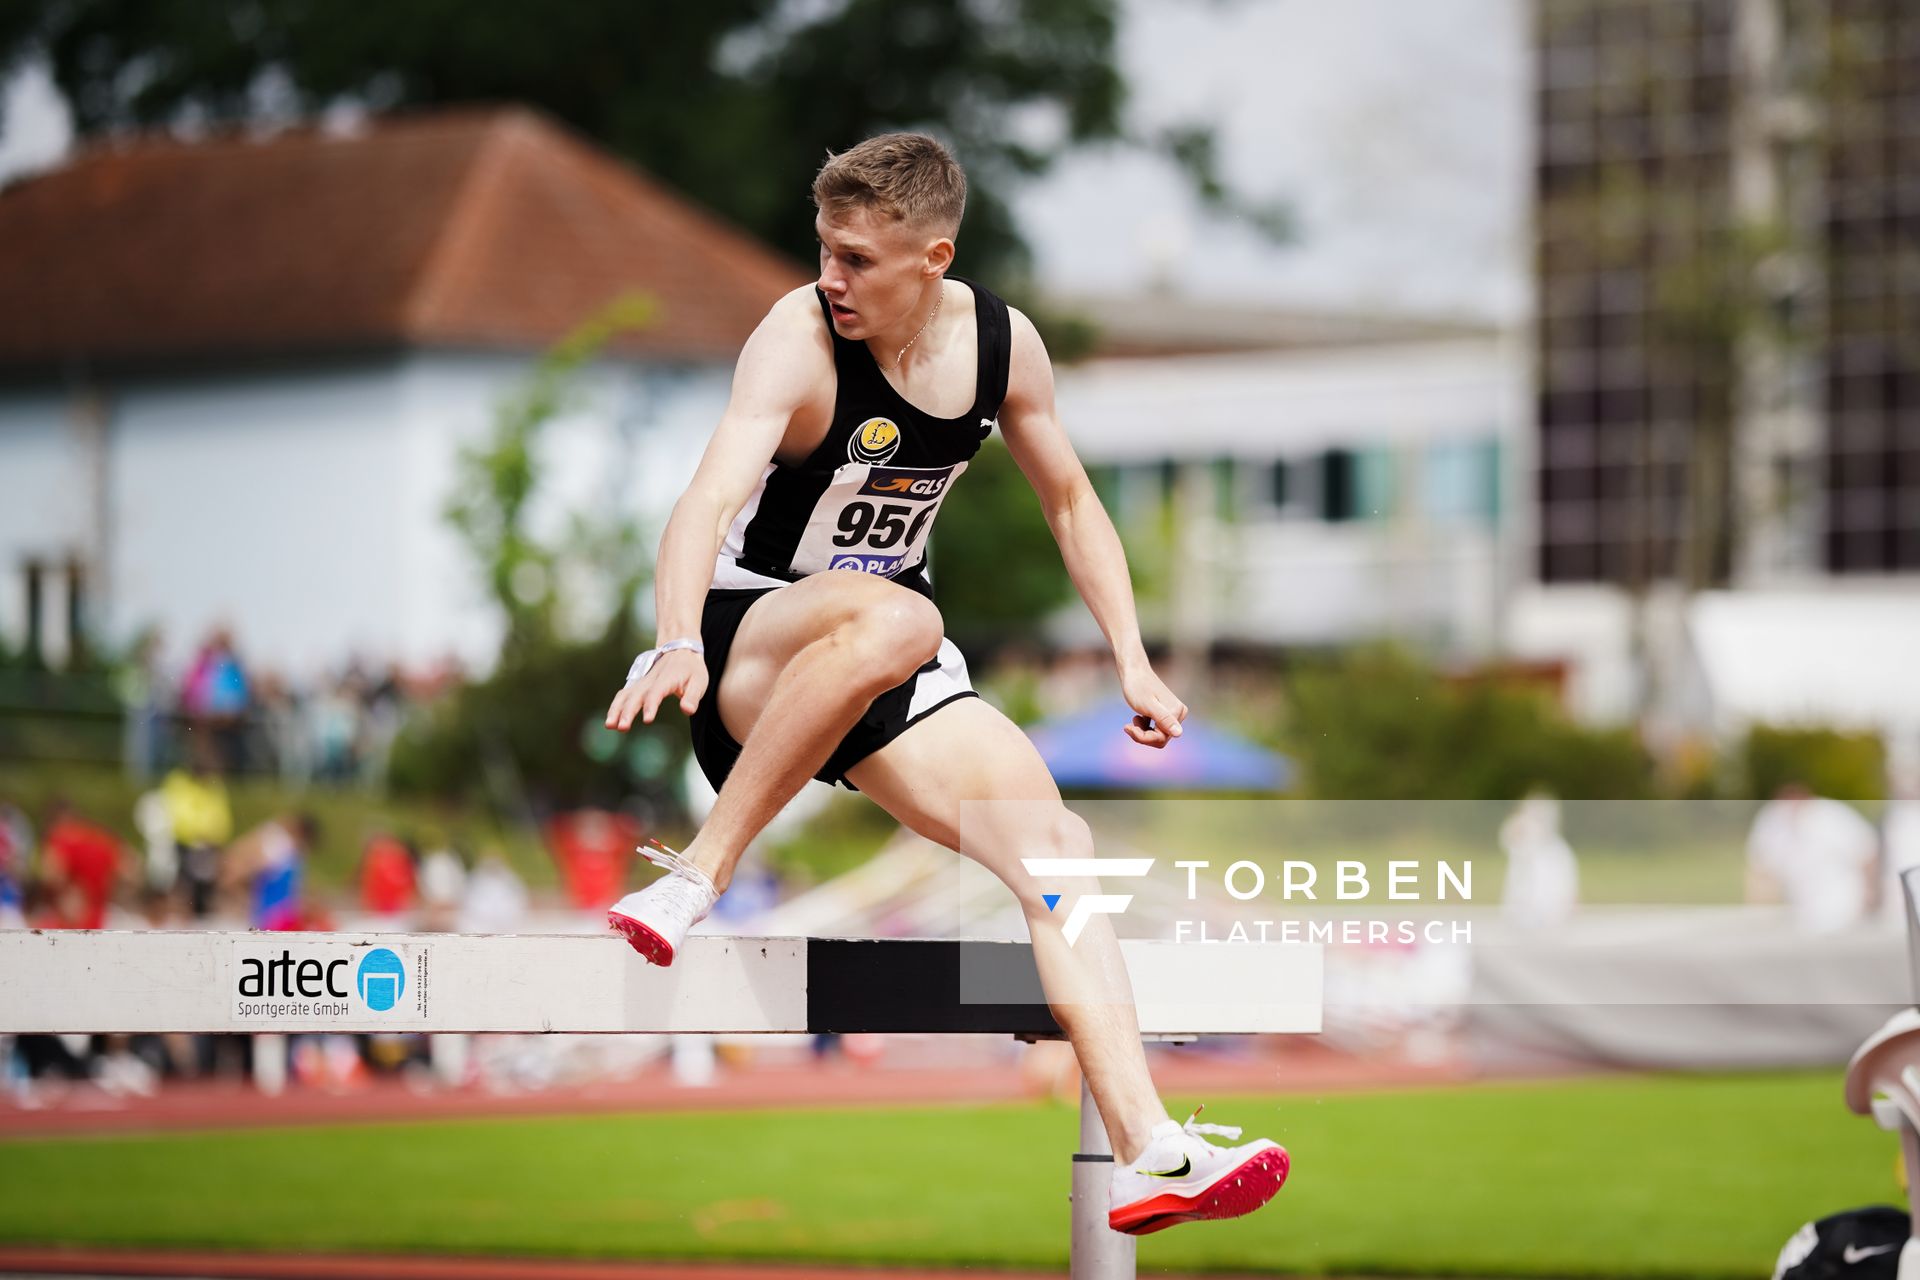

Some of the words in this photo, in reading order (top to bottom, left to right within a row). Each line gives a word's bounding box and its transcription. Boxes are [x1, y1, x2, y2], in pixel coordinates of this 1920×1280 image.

[909, 477, 946, 495] GLS
[238, 950, 349, 998] artec
[238, 1002, 309, 1018] Sportgeräte
[313, 1002, 349, 1016] GmbH
